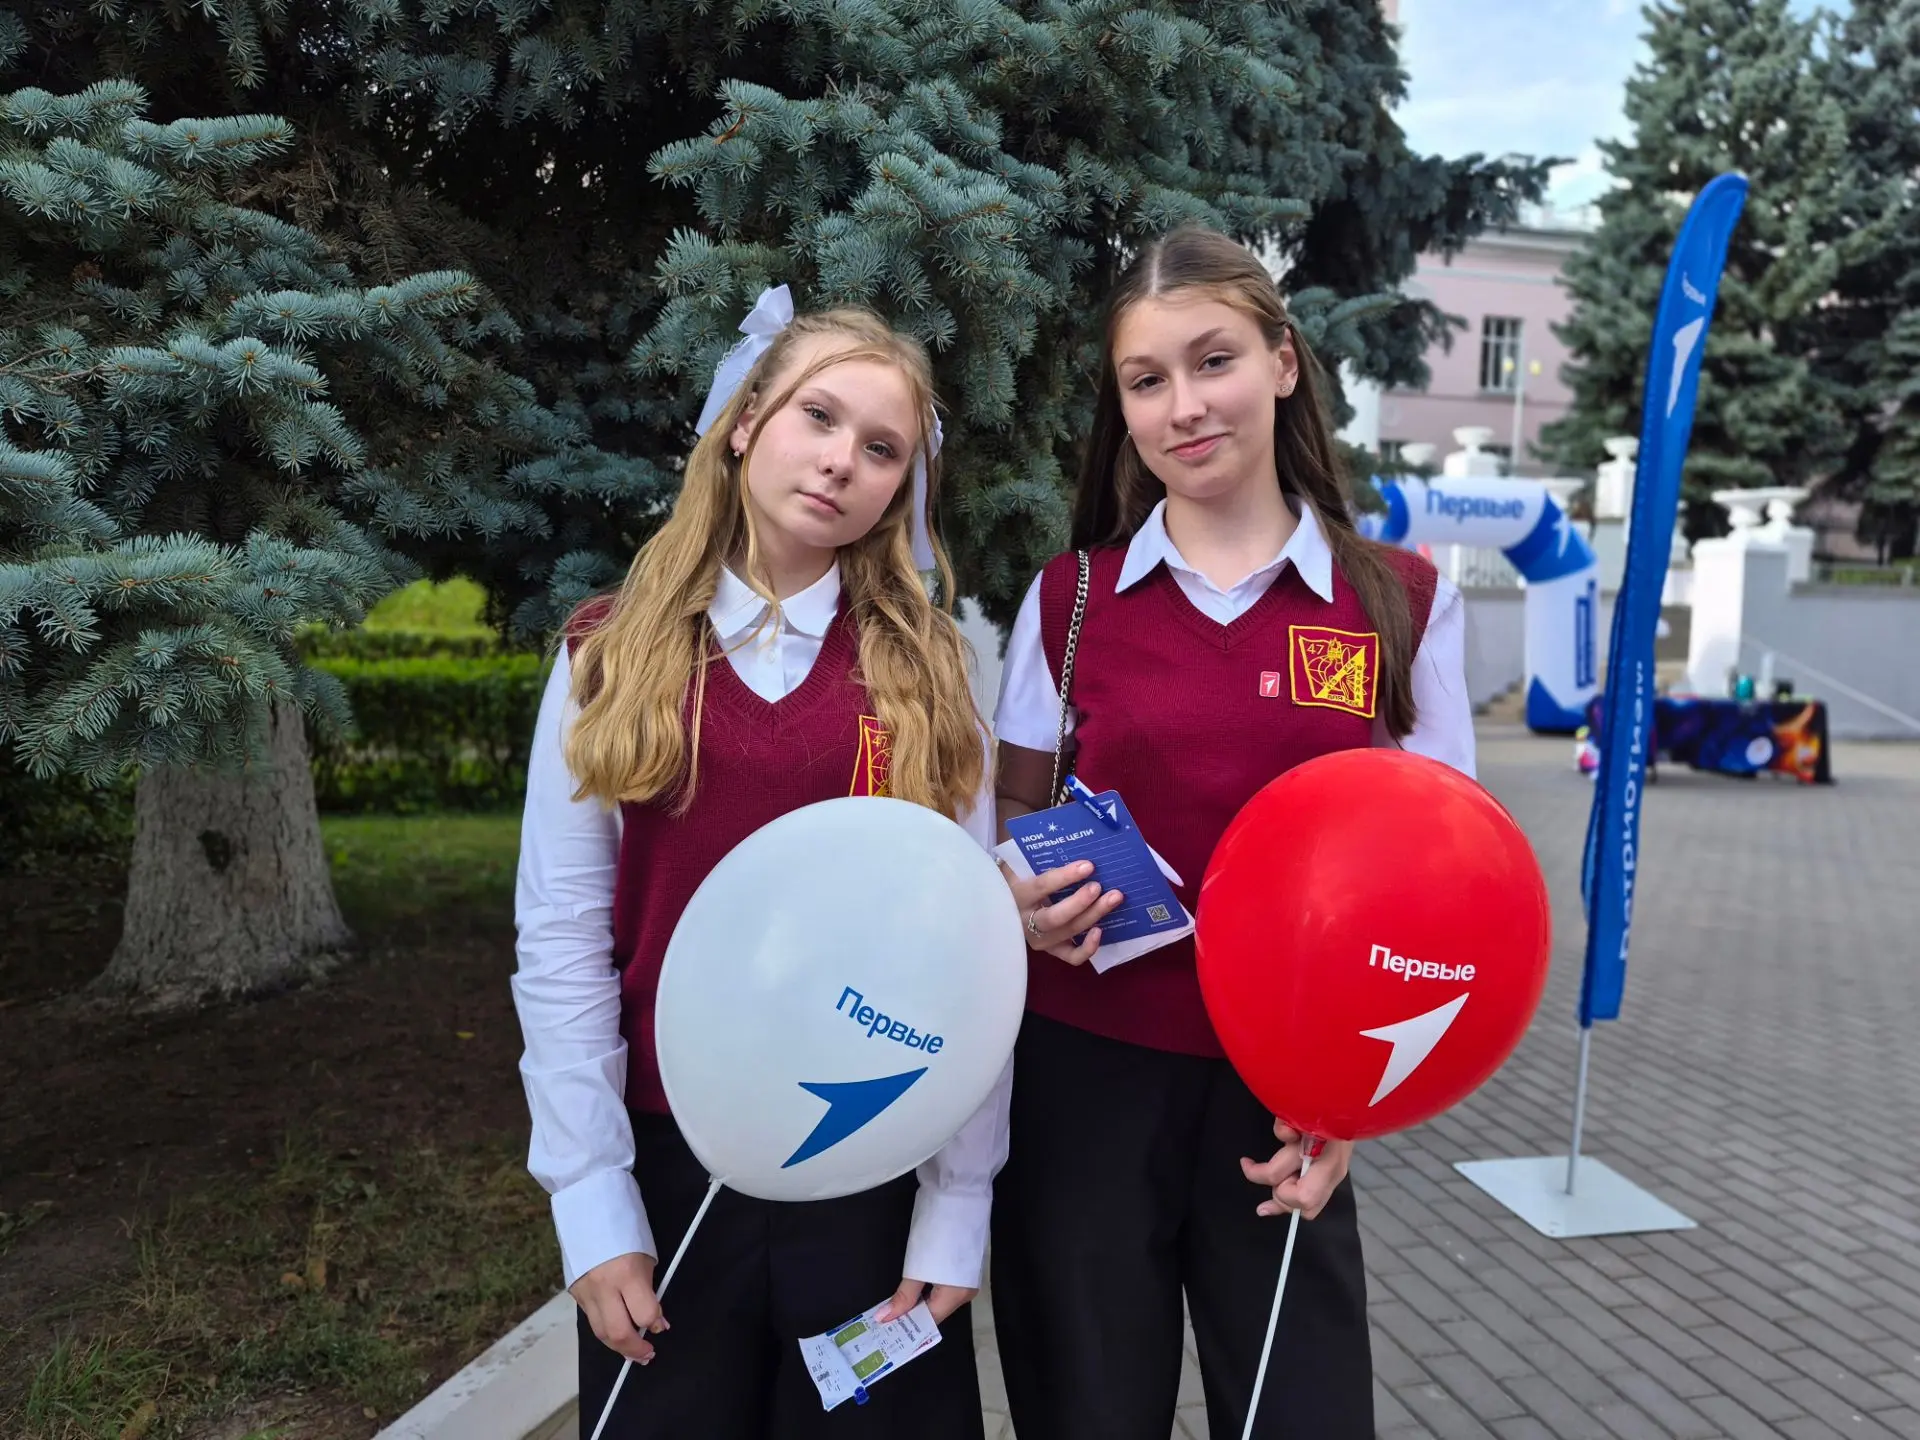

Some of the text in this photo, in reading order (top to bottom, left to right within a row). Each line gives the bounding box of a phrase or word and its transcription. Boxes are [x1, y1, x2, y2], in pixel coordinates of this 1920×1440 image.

[1426, 489, 1525, 524] Первые
[1307, 643, 1325, 655] 47
[1020, 833, 1045, 844] МОИ
[1025, 828, 1095, 851] ПЕРВЫЕ ЦЕЛИ
[1369, 943, 1476, 982] Первые
[836, 986, 944, 1054] Первые
